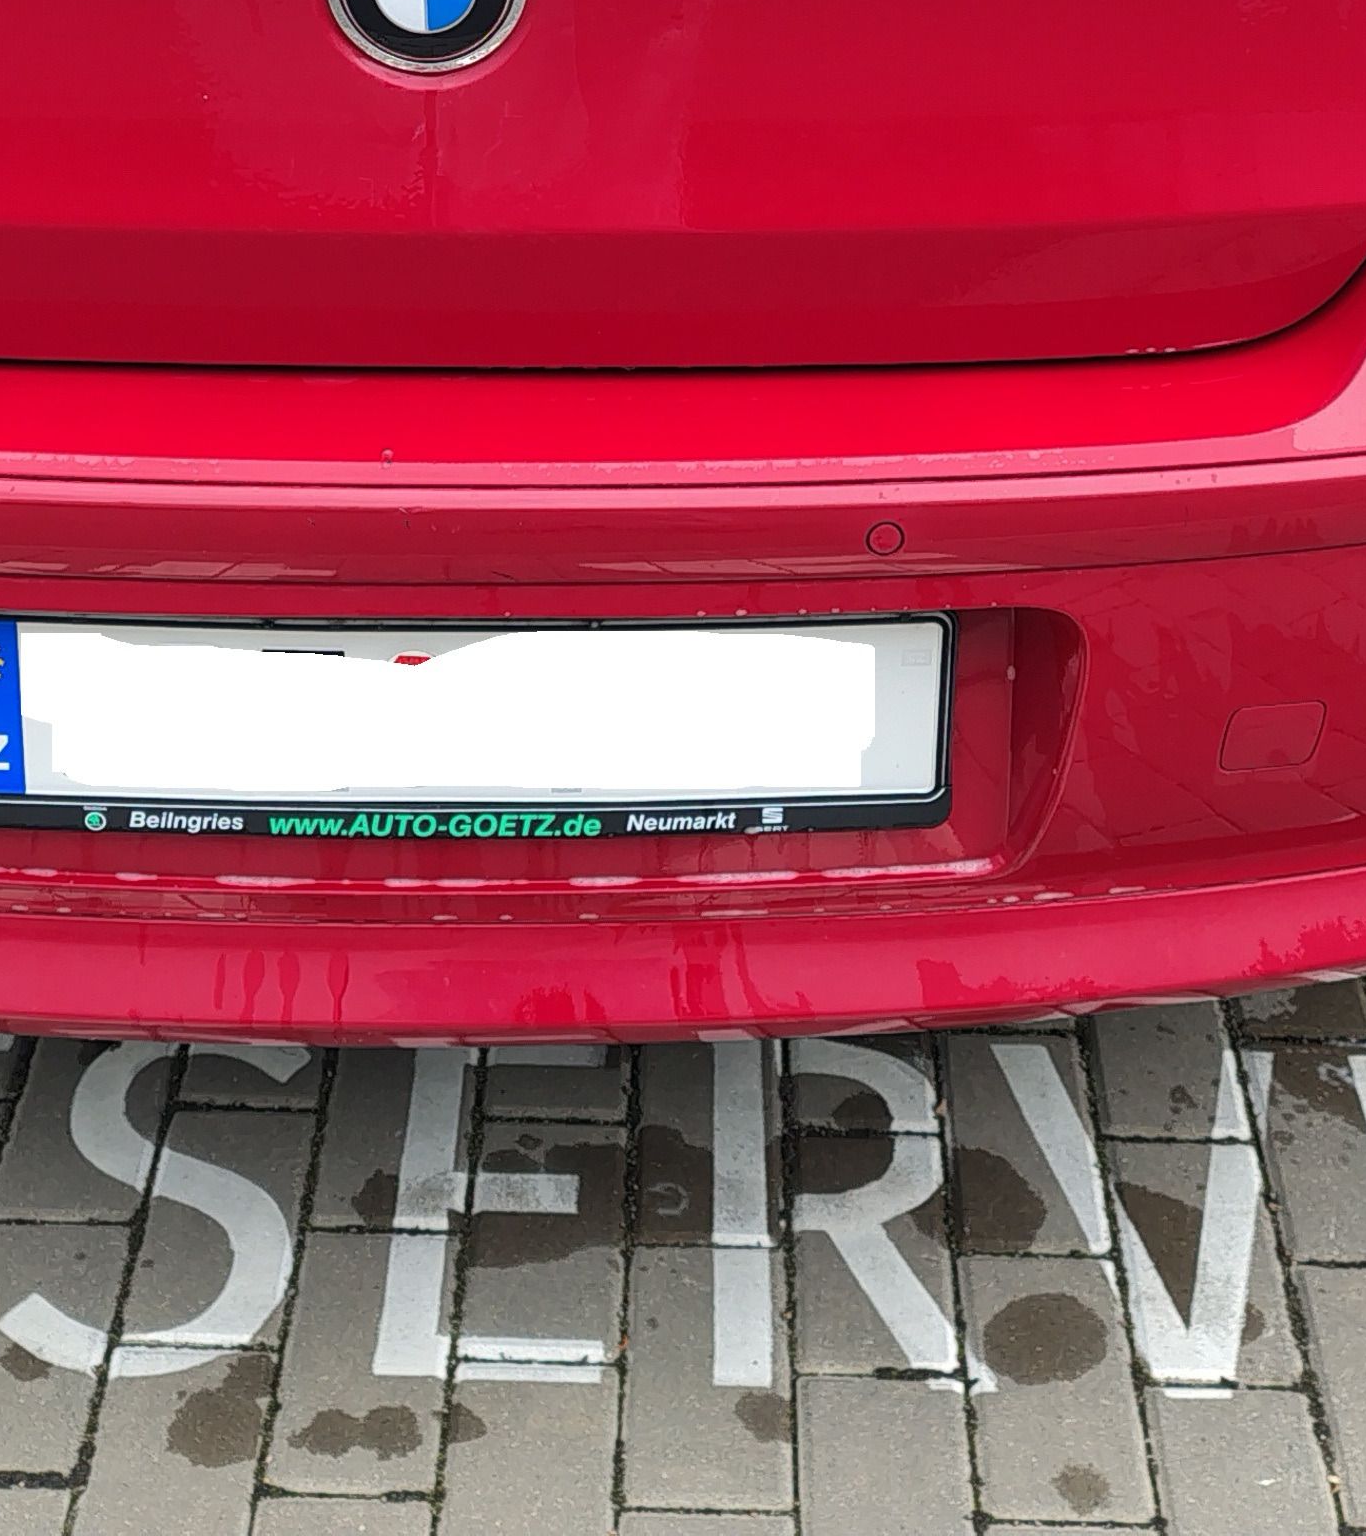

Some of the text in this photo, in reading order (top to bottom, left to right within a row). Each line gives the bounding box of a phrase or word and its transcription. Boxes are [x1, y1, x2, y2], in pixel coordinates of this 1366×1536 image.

[128, 810, 737, 838] Beilngries www.AUTO-GOETZ.de Neumarkt
